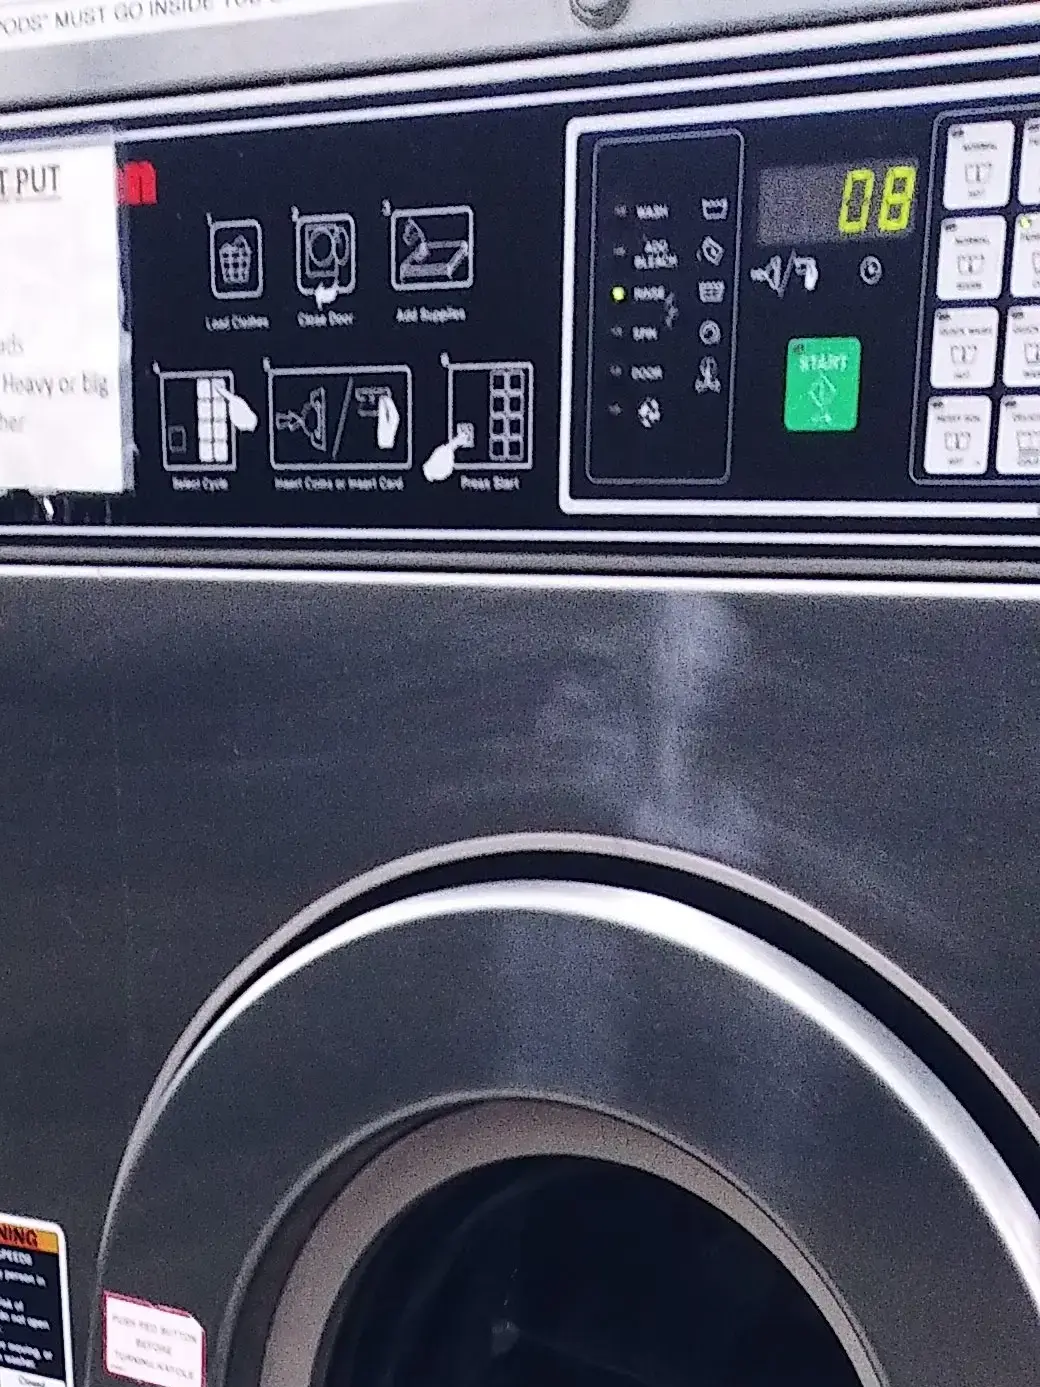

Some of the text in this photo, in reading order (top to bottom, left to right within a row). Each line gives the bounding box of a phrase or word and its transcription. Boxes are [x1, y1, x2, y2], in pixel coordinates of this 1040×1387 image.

[54, 7, 106, 29] MUST
[113, 1, 144, 22] GO
[15, 163, 61, 195] PUT
[838, 165, 917, 233] 08
[396, 307, 418, 323] Add
[798, 353, 849, 373] START
[2, 372, 53, 399] Heavy
[59, 379, 76, 394] or
[82, 370, 109, 398] big
[138, 1320, 158, 1334] RED
[160, 1324, 198, 1344] BUTTON
[135, 1338, 172, 1356] BEFORE
